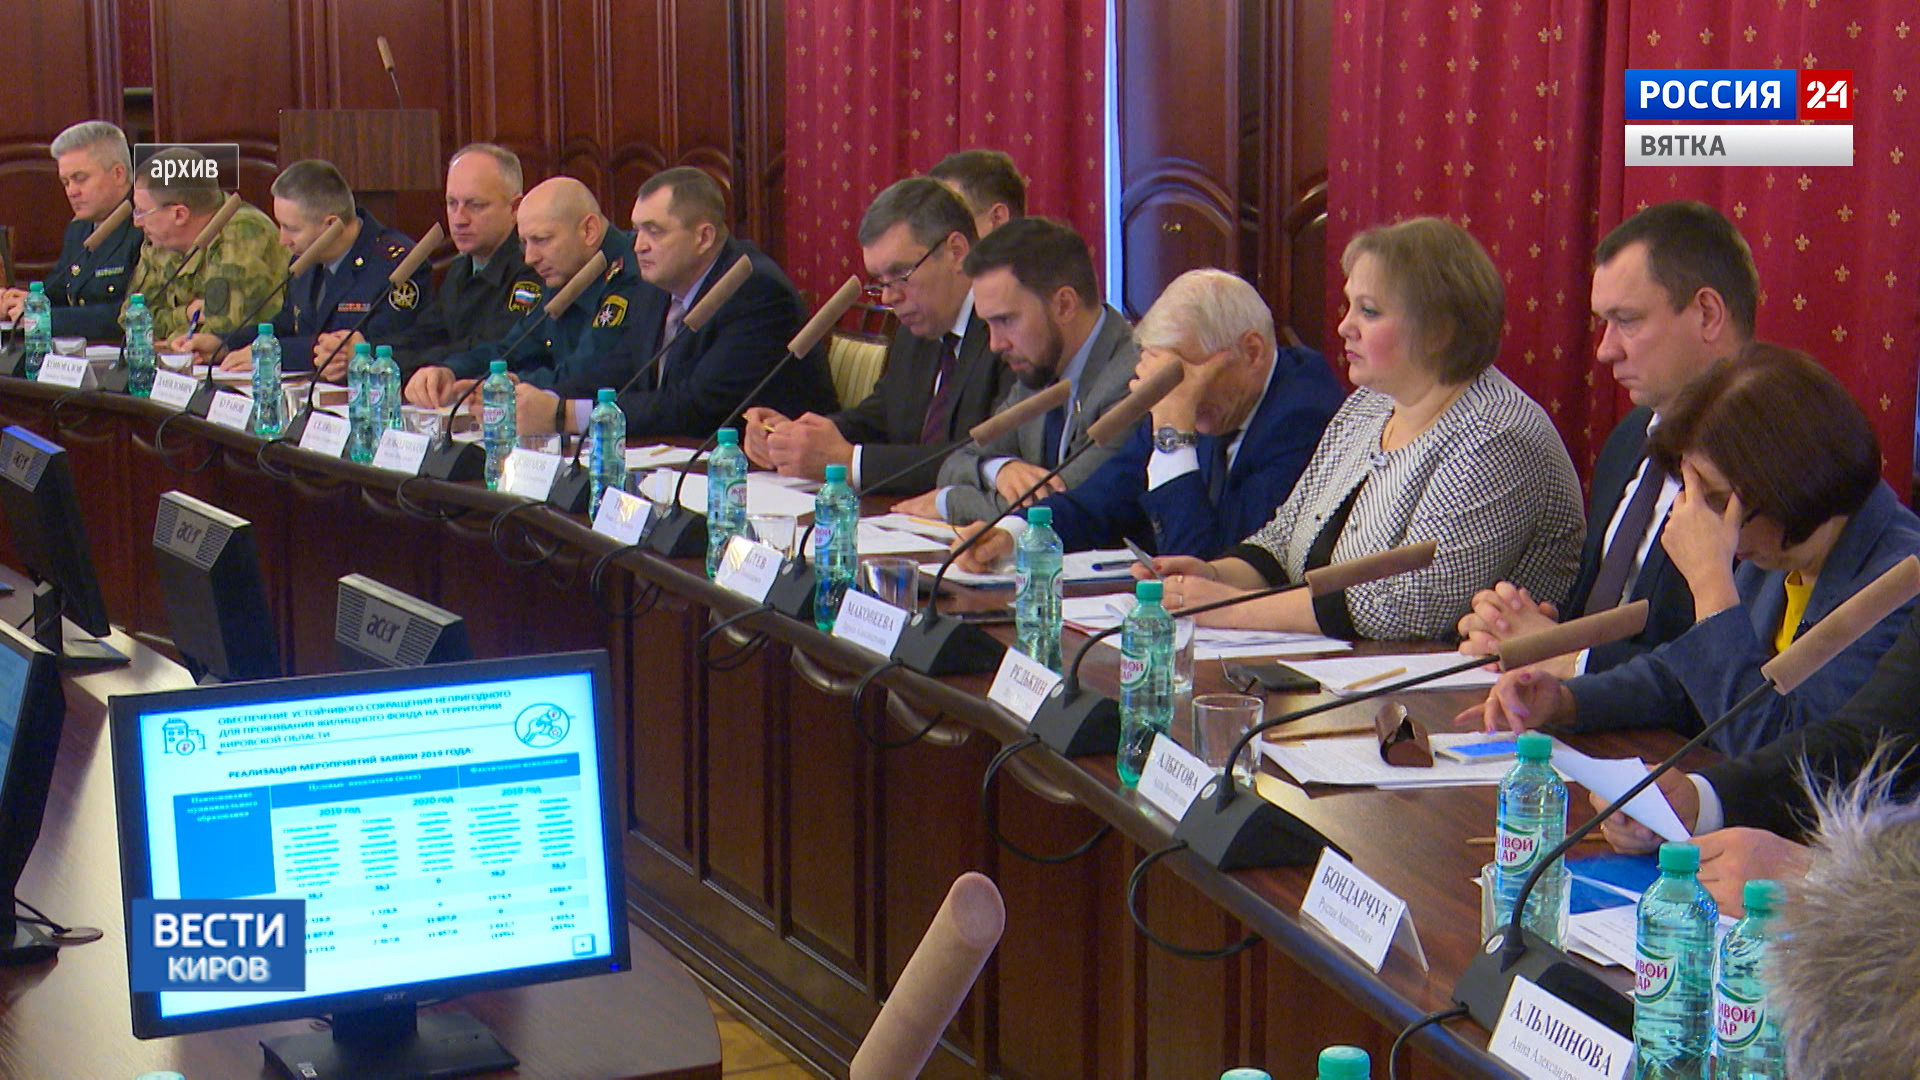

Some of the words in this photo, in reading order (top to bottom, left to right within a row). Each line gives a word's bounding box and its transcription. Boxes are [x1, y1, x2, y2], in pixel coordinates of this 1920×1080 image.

[176, 521, 202, 544] acer
[366, 613, 401, 643] acer
[218, 711, 288, 725] ОБЕСПЕЧЕНИЕ
[292, 703, 364, 718] УСТОЙЧИВОГО
[366, 697, 433, 712] СОКРАЩЕНИЯ
[435, 690, 511, 704] НЕПРИГОДНОГО
[219, 727, 240, 740] ДЛЯ
[243, 721, 314, 735] ПРОЖИВАНИЯ
[317, 713, 384, 728] ЖИЛИЩНОГО
[387, 709, 422, 721] ФОНДА
[425, 708, 439, 717] НА
[442, 702, 502, 714] ТЕРРИТОРИИ
[220, 736, 281, 749] КИРОВСКОЙ
[284, 731, 330, 743] ОБЛАСТИ
[228, 764, 297, 779] РЕАЛИЗАЦИЯ
[299, 756, 377, 772] МЕРОПРИЯТИЙ
[380, 752, 418, 764] ЗАЯВКИ
[421, 750, 443, 760] 2019
[413, 796, 436, 807] 2020
[1321, 865, 1393, 926] БОНДАРЧУК
[1509, 998, 1614, 1077] АЛЬМИНОВА
[1509, 1035, 1531, 1058] Анна
